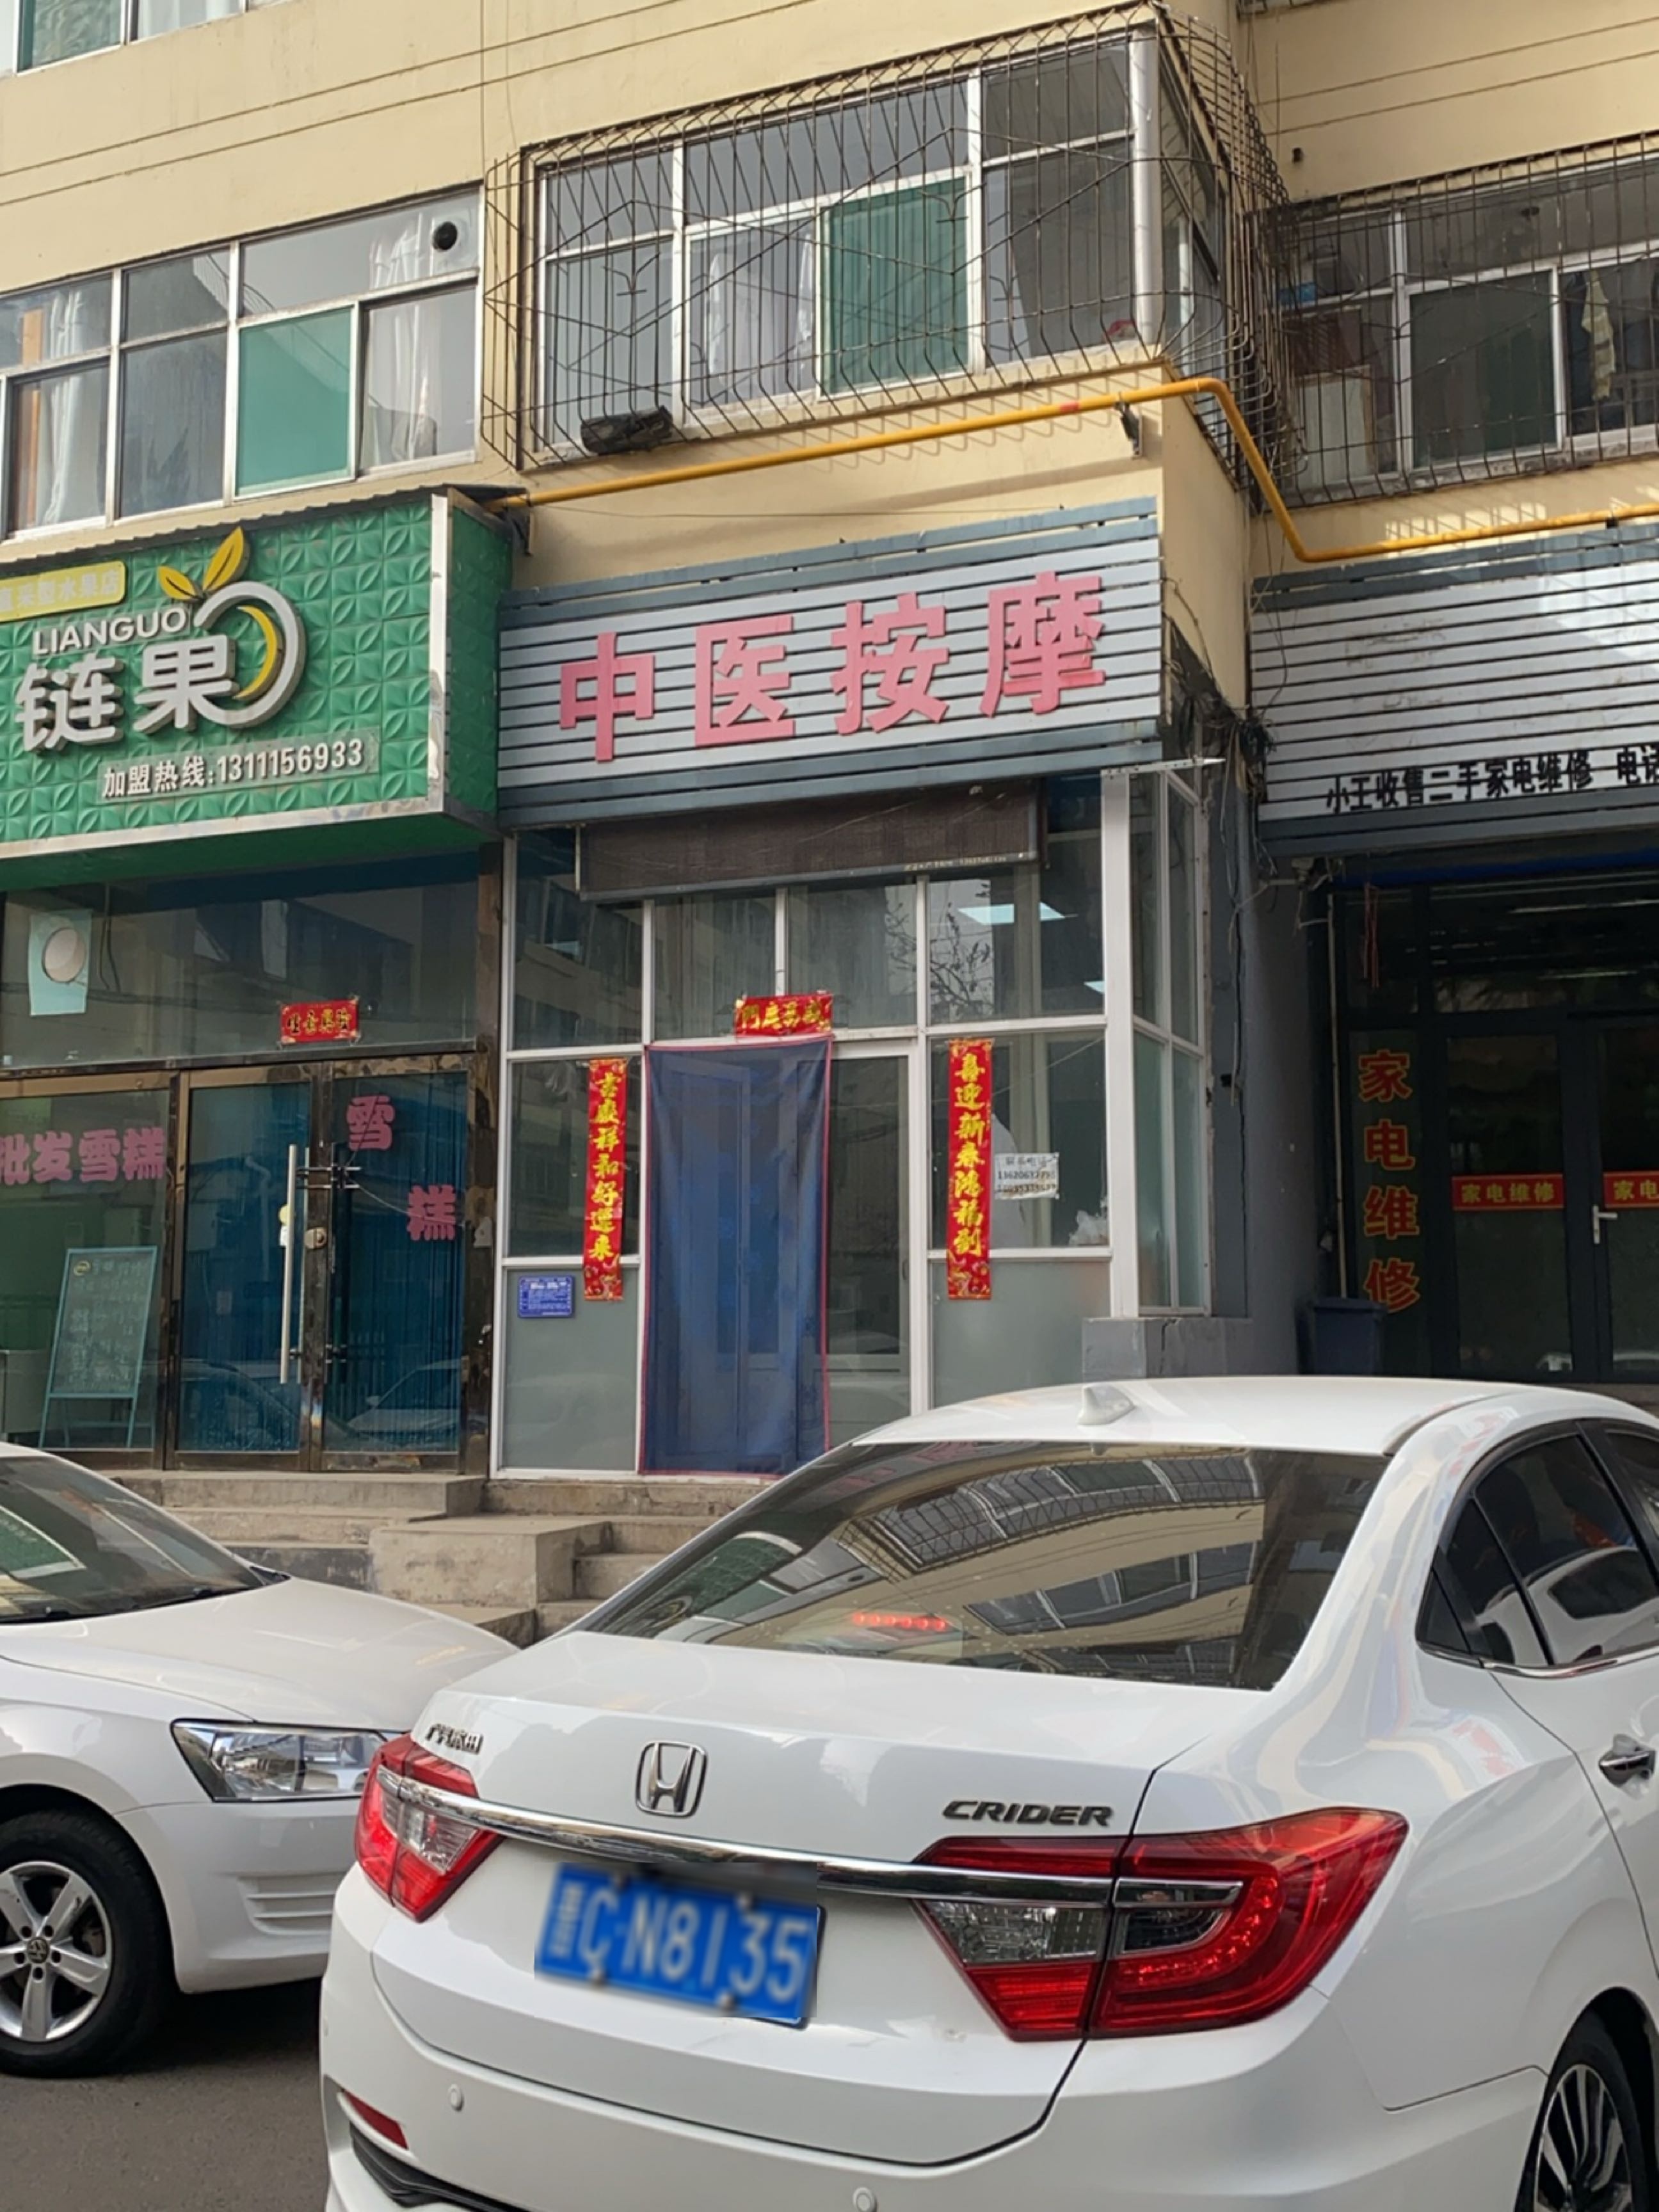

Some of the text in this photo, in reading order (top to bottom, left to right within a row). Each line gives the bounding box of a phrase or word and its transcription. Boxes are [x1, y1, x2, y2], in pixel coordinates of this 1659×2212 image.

[33, 607, 188, 656] LIANGUO
[15, 634, 240, 751] 链果
[560, 571, 1105, 762] 中医按摩
[0, 1126, 165, 1185] 批发雪糕
[1358, 1049, 1420, 1313] 家电维修
[1461, 1180, 1555, 1203] 家电维修
[1613, 1179, 1659, 1199] 家电
[942, 1800, 1114, 1828] CRIDER
